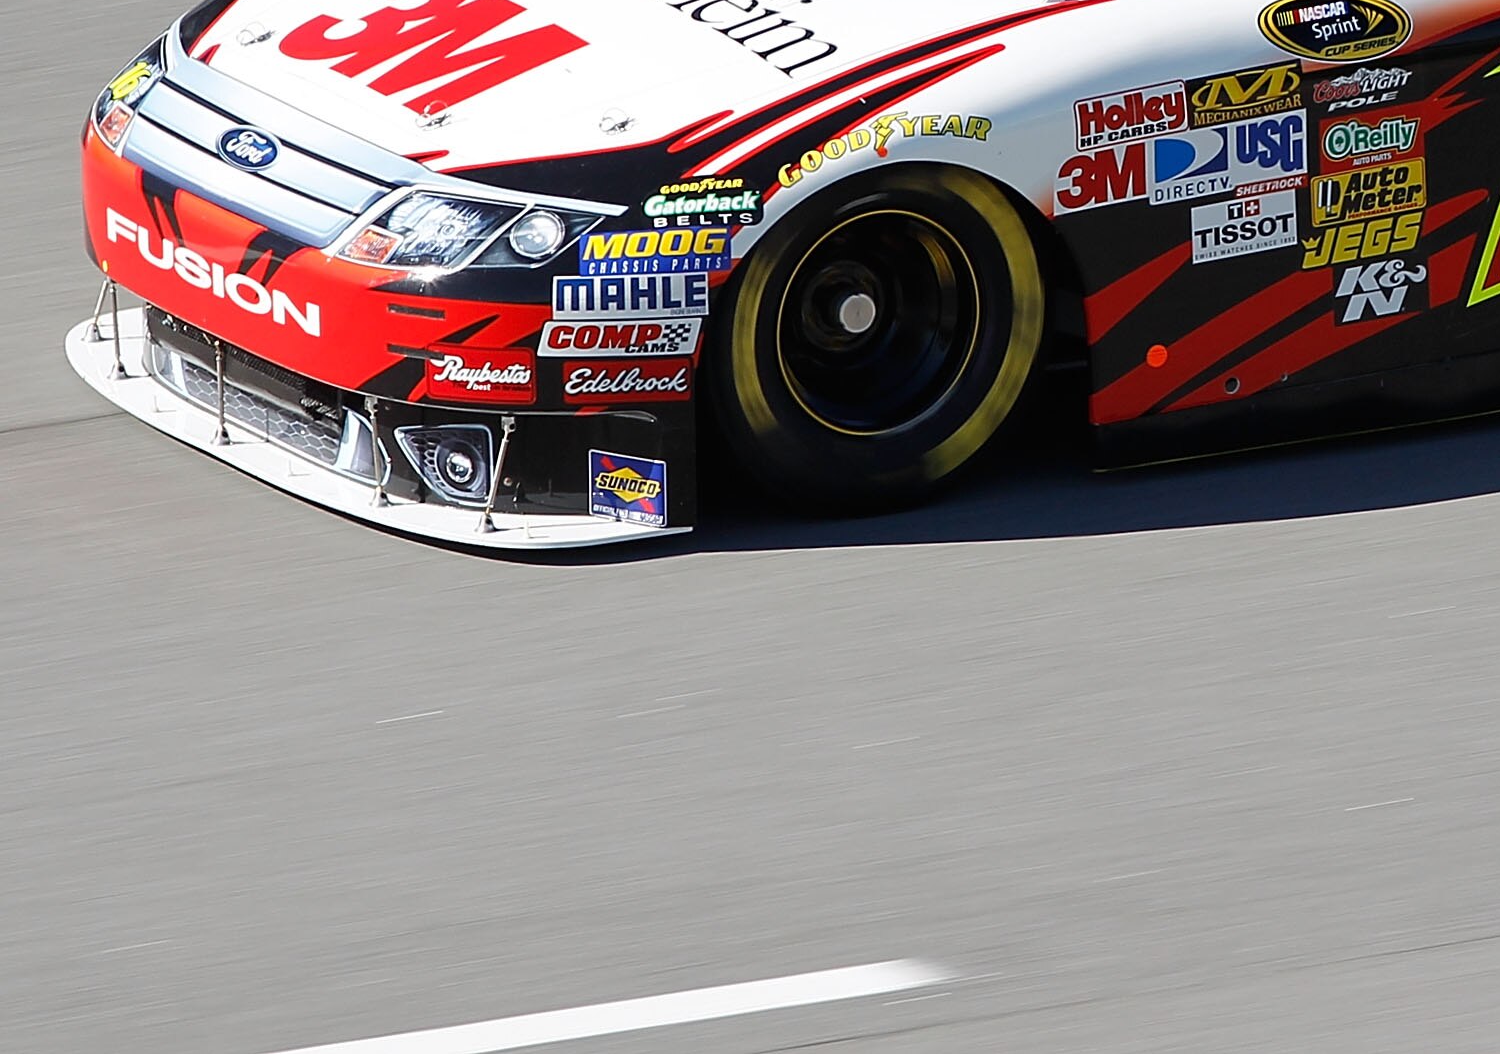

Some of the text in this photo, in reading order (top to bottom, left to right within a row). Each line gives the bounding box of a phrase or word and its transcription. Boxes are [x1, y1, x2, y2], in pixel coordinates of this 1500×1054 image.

[1299, 1, 1347, 23] NASCAR
[1311, 15, 1362, 42] Sprint
[1324, 36, 1397, 58] CUP SERIES
[1313, 69, 1413, 104] Coors LIGHT
[1328, 90, 1399, 112] POLE
[1077, 91, 1185, 137] Holley
[1193, 94, 1302, 127] MECHANIX WEAR
[225, 131, 273, 164] Ford
[1079, 121, 1168, 148] HP CARBS
[1235, 114, 1305, 173] USG
[1327, 120, 1413, 157] O'Reilly
[777, 112, 992, 188] GOODYEAR
[1353, 152, 1392, 166] AUTO PARTS
[659, 178, 744, 195] GOODYEAR
[1056, 142, 1146, 209] 3M
[1155, 176, 1231, 203] DIRECTV
[1235, 175, 1304, 197] SHEETROCK
[1345, 166, 1410, 195] Auto
[645, 189, 761, 217] Gatorback
[1340, 184, 1423, 221] Meter
[653, 212, 753, 228] BELTS
[1194, 212, 1295, 249] TISSOT
[583, 228, 728, 261] MOOG
[1194, 252, 1219, 262] SWISS
[1219, 244, 1254, 257] WATCHES
[1256, 240, 1278, 249] SINCE
[1301, 211, 1423, 269] JEGS
[106, 206, 321, 338] FUSION
[588, 256, 722, 275] CHASSIS PARTS
[1335, 259, 1427, 298] K&
[556, 275, 706, 312] MAHLE
[1342, 285, 1409, 323] N
[547, 322, 663, 351] COMP
[624, 341, 681, 354] CAMS
[430, 354, 532, 391] Raybestos
[473, 383, 492, 391] best
[564, 366, 688, 396] Edelbrock
[599, 473, 657, 496] SUNOCO
